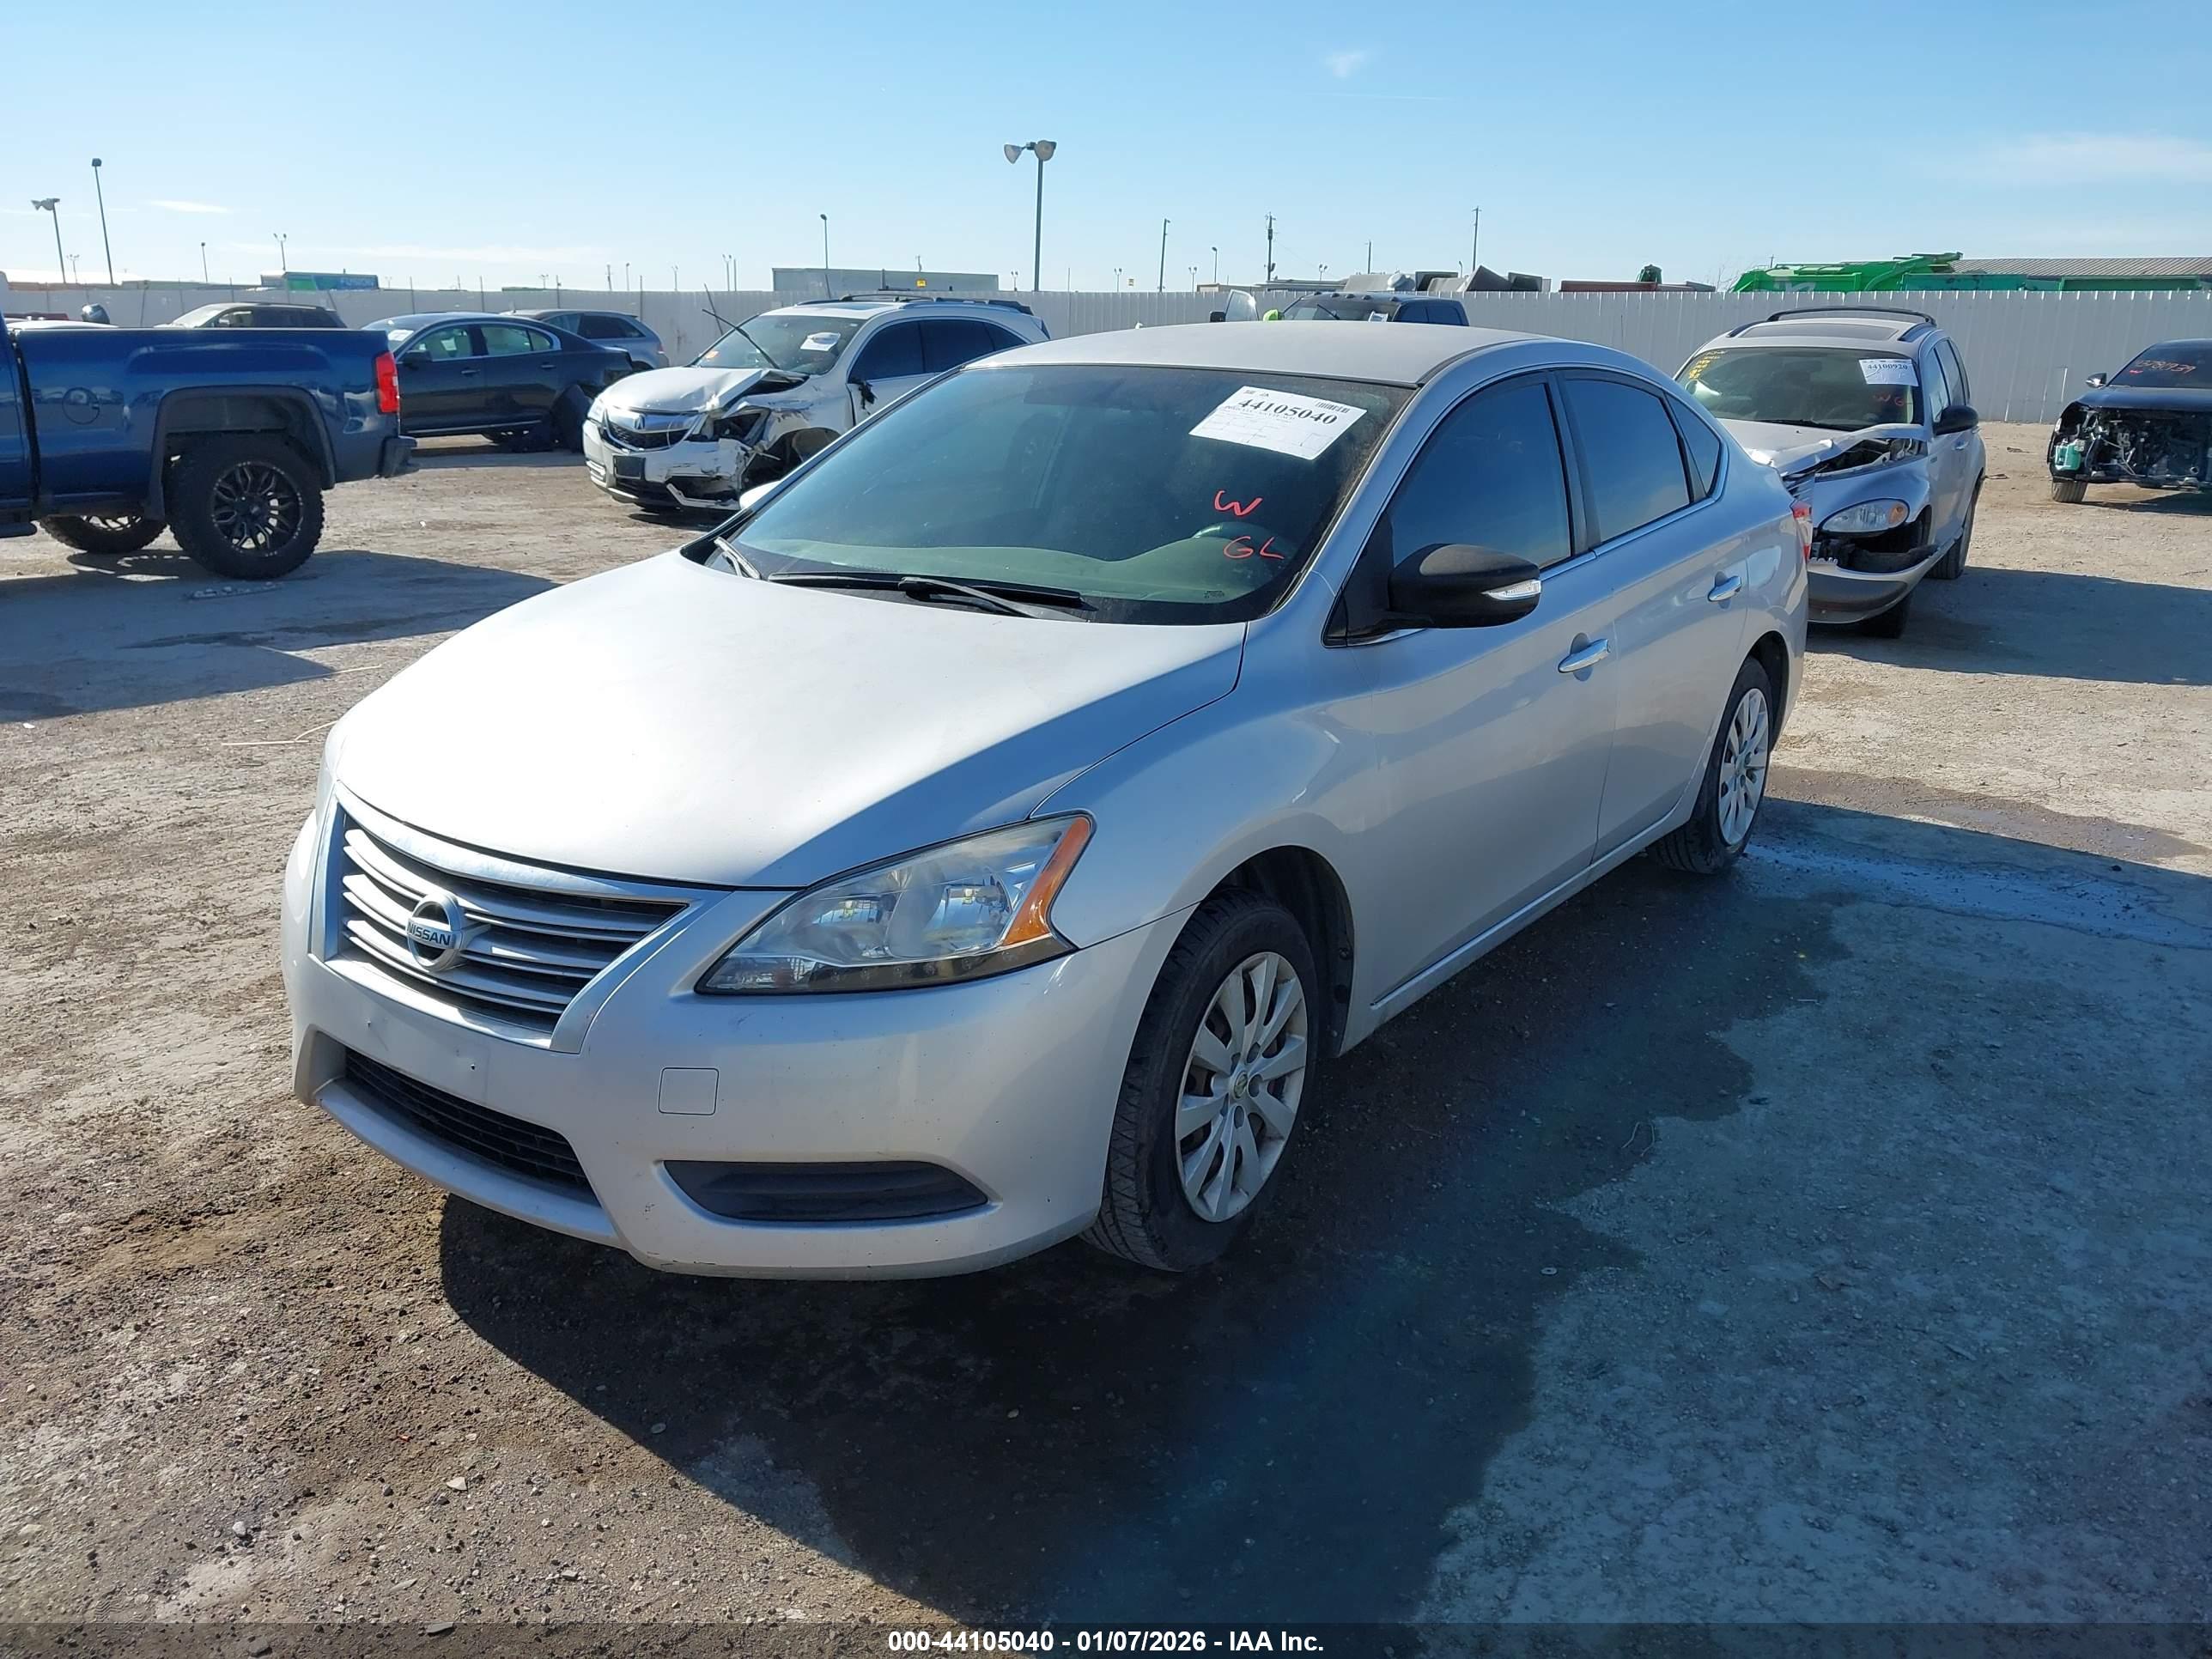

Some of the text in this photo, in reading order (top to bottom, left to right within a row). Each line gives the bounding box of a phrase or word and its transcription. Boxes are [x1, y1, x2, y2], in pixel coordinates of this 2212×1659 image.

[1238, 398, 1338, 425] 44105040
[1213, 489, 1263, 516] W
[1223, 536, 1285, 559] GL
[407, 921, 451, 945] NISSAN
